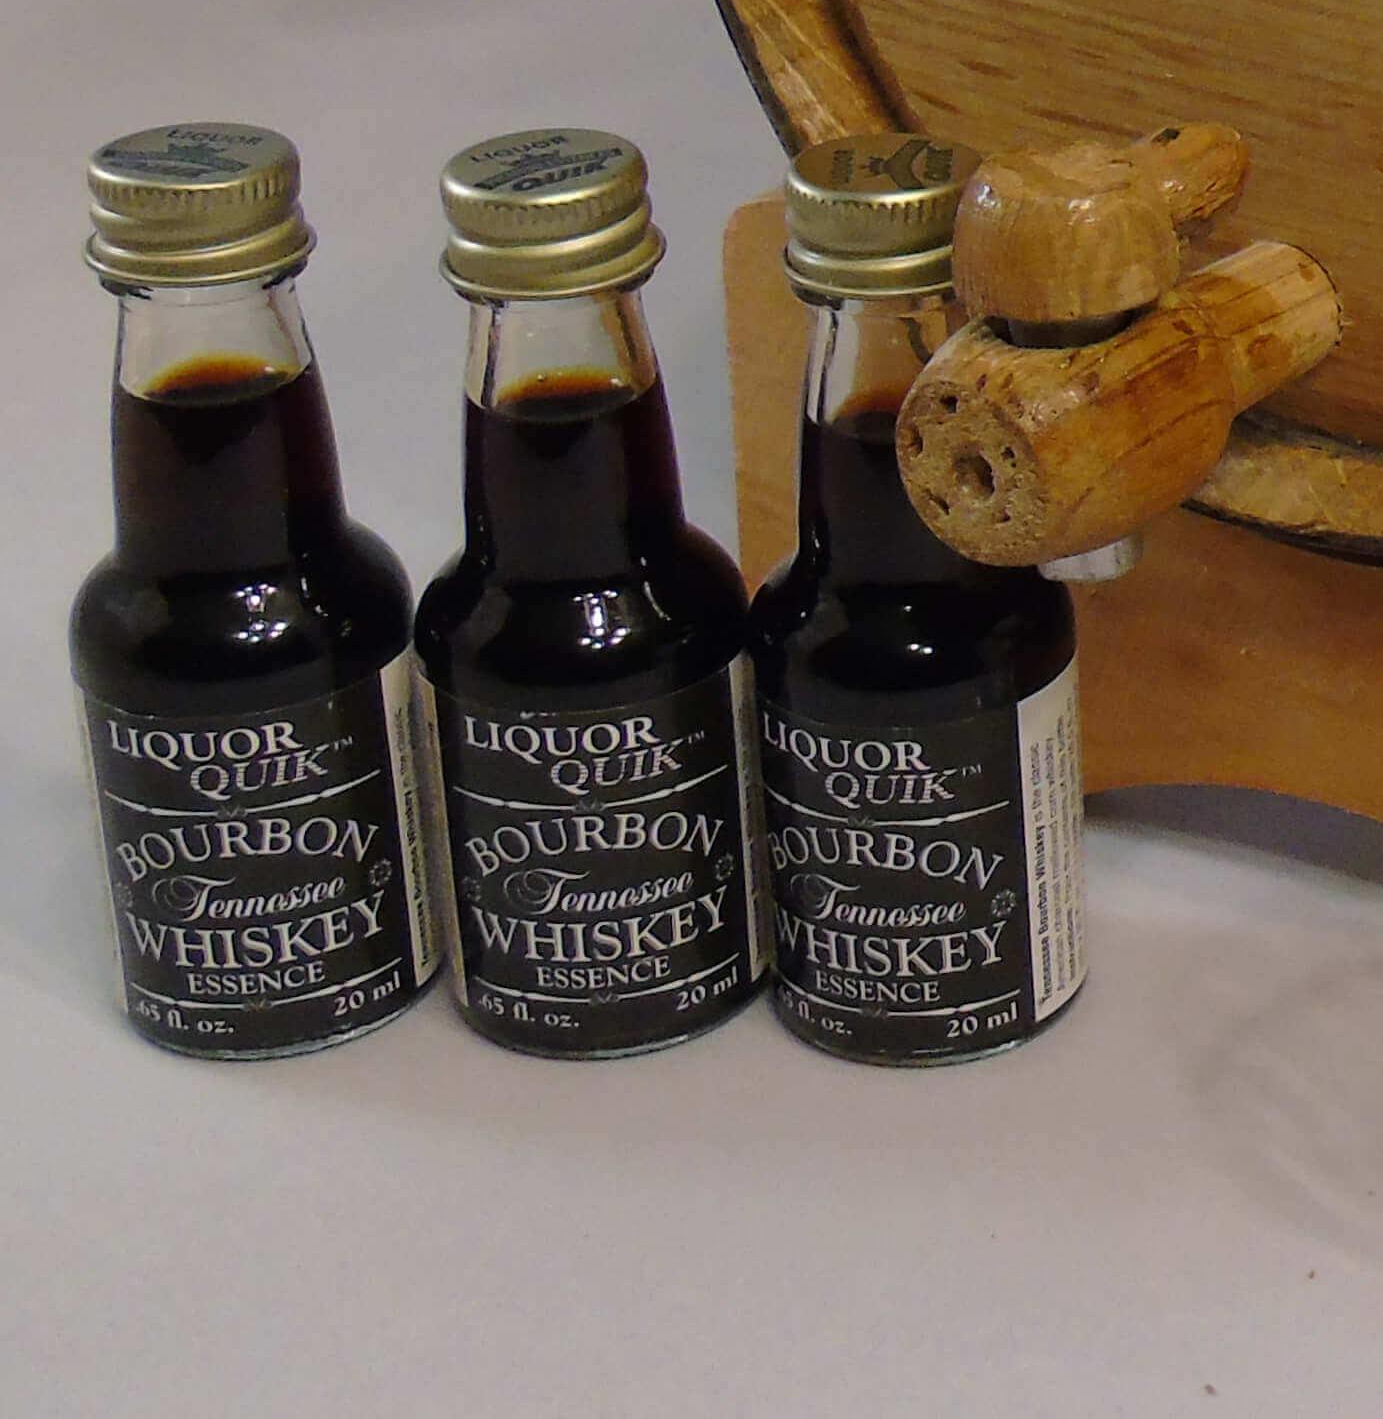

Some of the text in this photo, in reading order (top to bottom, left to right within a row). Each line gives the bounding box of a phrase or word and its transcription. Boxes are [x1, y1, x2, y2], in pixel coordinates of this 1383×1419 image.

[107, 719, 304, 771] LIQUOR
[464, 715, 662, 764] LIQUOR
[762, 713, 931, 772] LIQUOR
[116, 816, 380, 882] BOURBON
[464, 811, 724, 878] BOURBON
[768, 827, 1003, 891] BOURBON
[1034, 825, 1047, 881] Whiskey
[153, 874, 346, 922] Tennessee
[503, 868, 694, 915] Tennessee
[789, 873, 967, 928] Tennessee
[126, 888, 385, 970] WHISKEY
[472, 885, 727, 964] WHISKEY
[776, 907, 1007, 977] WHISKEY
[188, 960, 326, 996] ESSENCE
[333, 971, 401, 1017] 20 ml
[537, 956, 672, 990] ESSENCE
[676, 966, 739, 1011] 20 ml
[815, 969, 941, 1004] ESSENCE
[168, 1009, 189, 1030] fl.
[197, 1020, 234, 1034] oz.
[513, 1001, 536, 1022] fl.
[544, 1013, 580, 1028] oz.
[821, 1017, 853, 1035] oz.
[947, 1002, 1019, 1038] 20 ml
